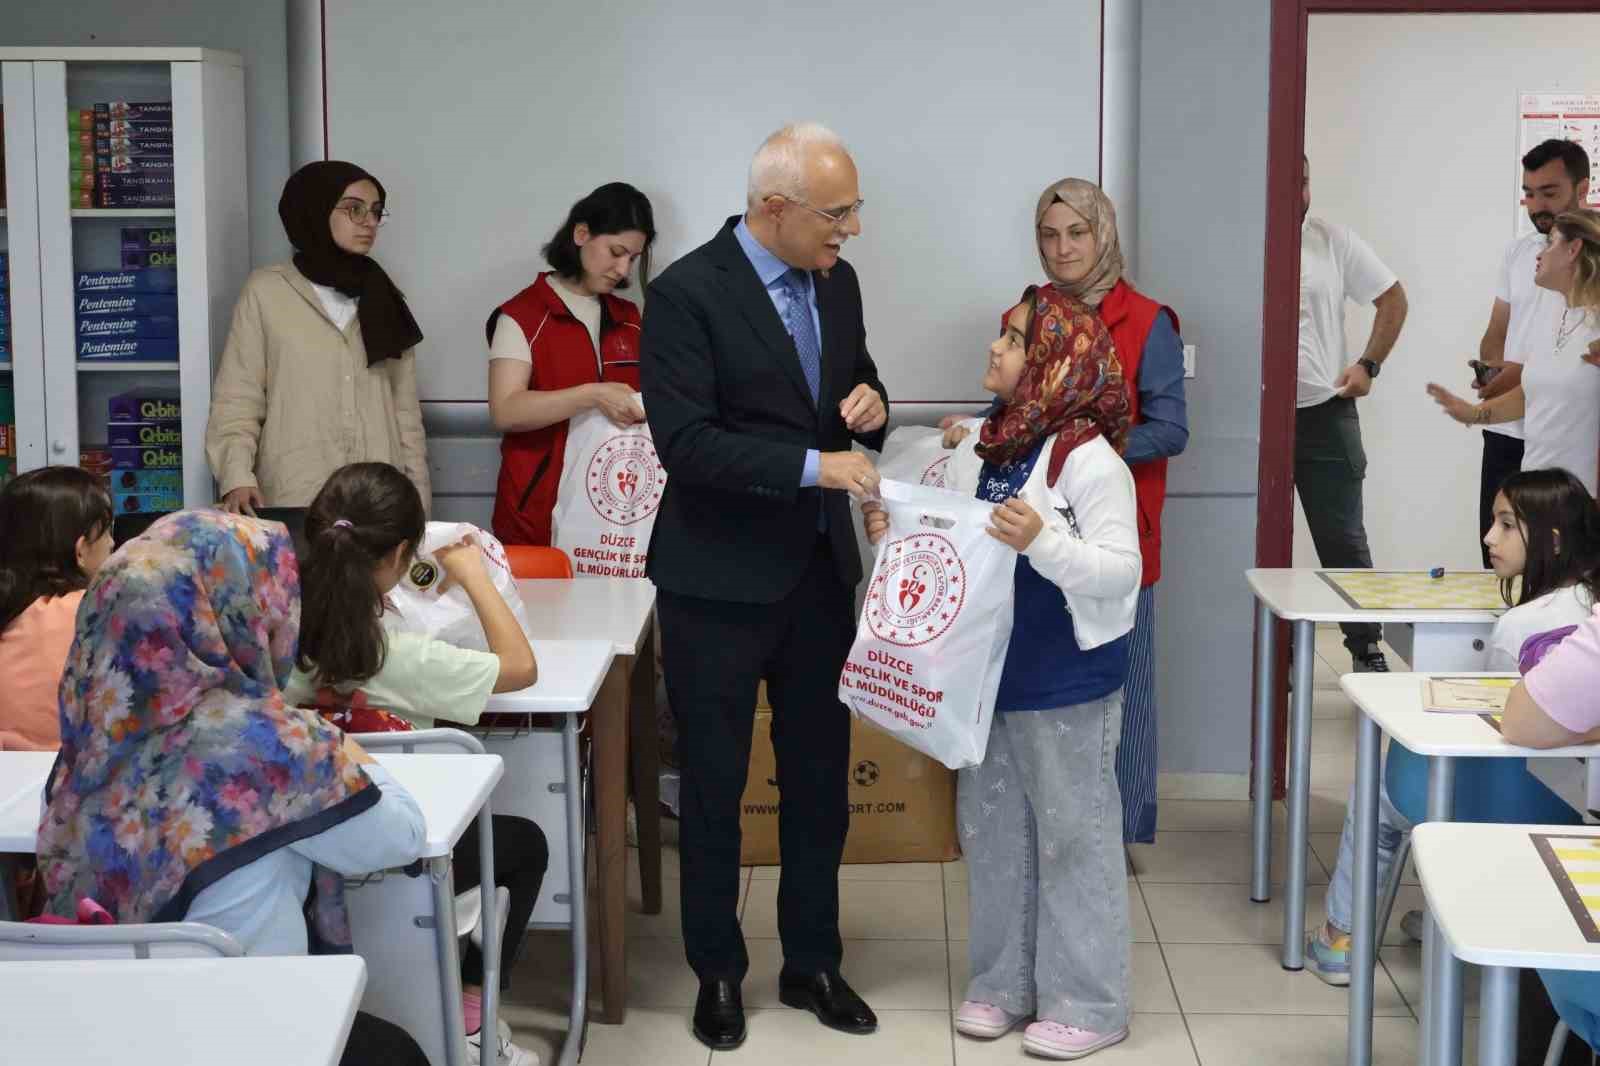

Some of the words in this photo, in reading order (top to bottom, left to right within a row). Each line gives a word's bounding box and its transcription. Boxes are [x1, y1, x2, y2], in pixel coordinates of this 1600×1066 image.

[600, 532, 636, 548] DÜZCE
[574, 547, 617, 562] GENÇLİK
[619, 553, 631, 563] VE
[633, 554, 647, 564] SP
[577, 561, 586, 573] İL
[587, 563, 647, 579] MÜDÜRLÜ
[867, 649, 913, 676] DÜZCE
[845, 661, 891, 684] ENÇLİK
[893, 676, 909, 692] VE
[911, 683, 944, 704] SPOR
[841, 673, 853, 689] İL
[856, 679, 936, 718] MÜDÜRLÜĞÜ
